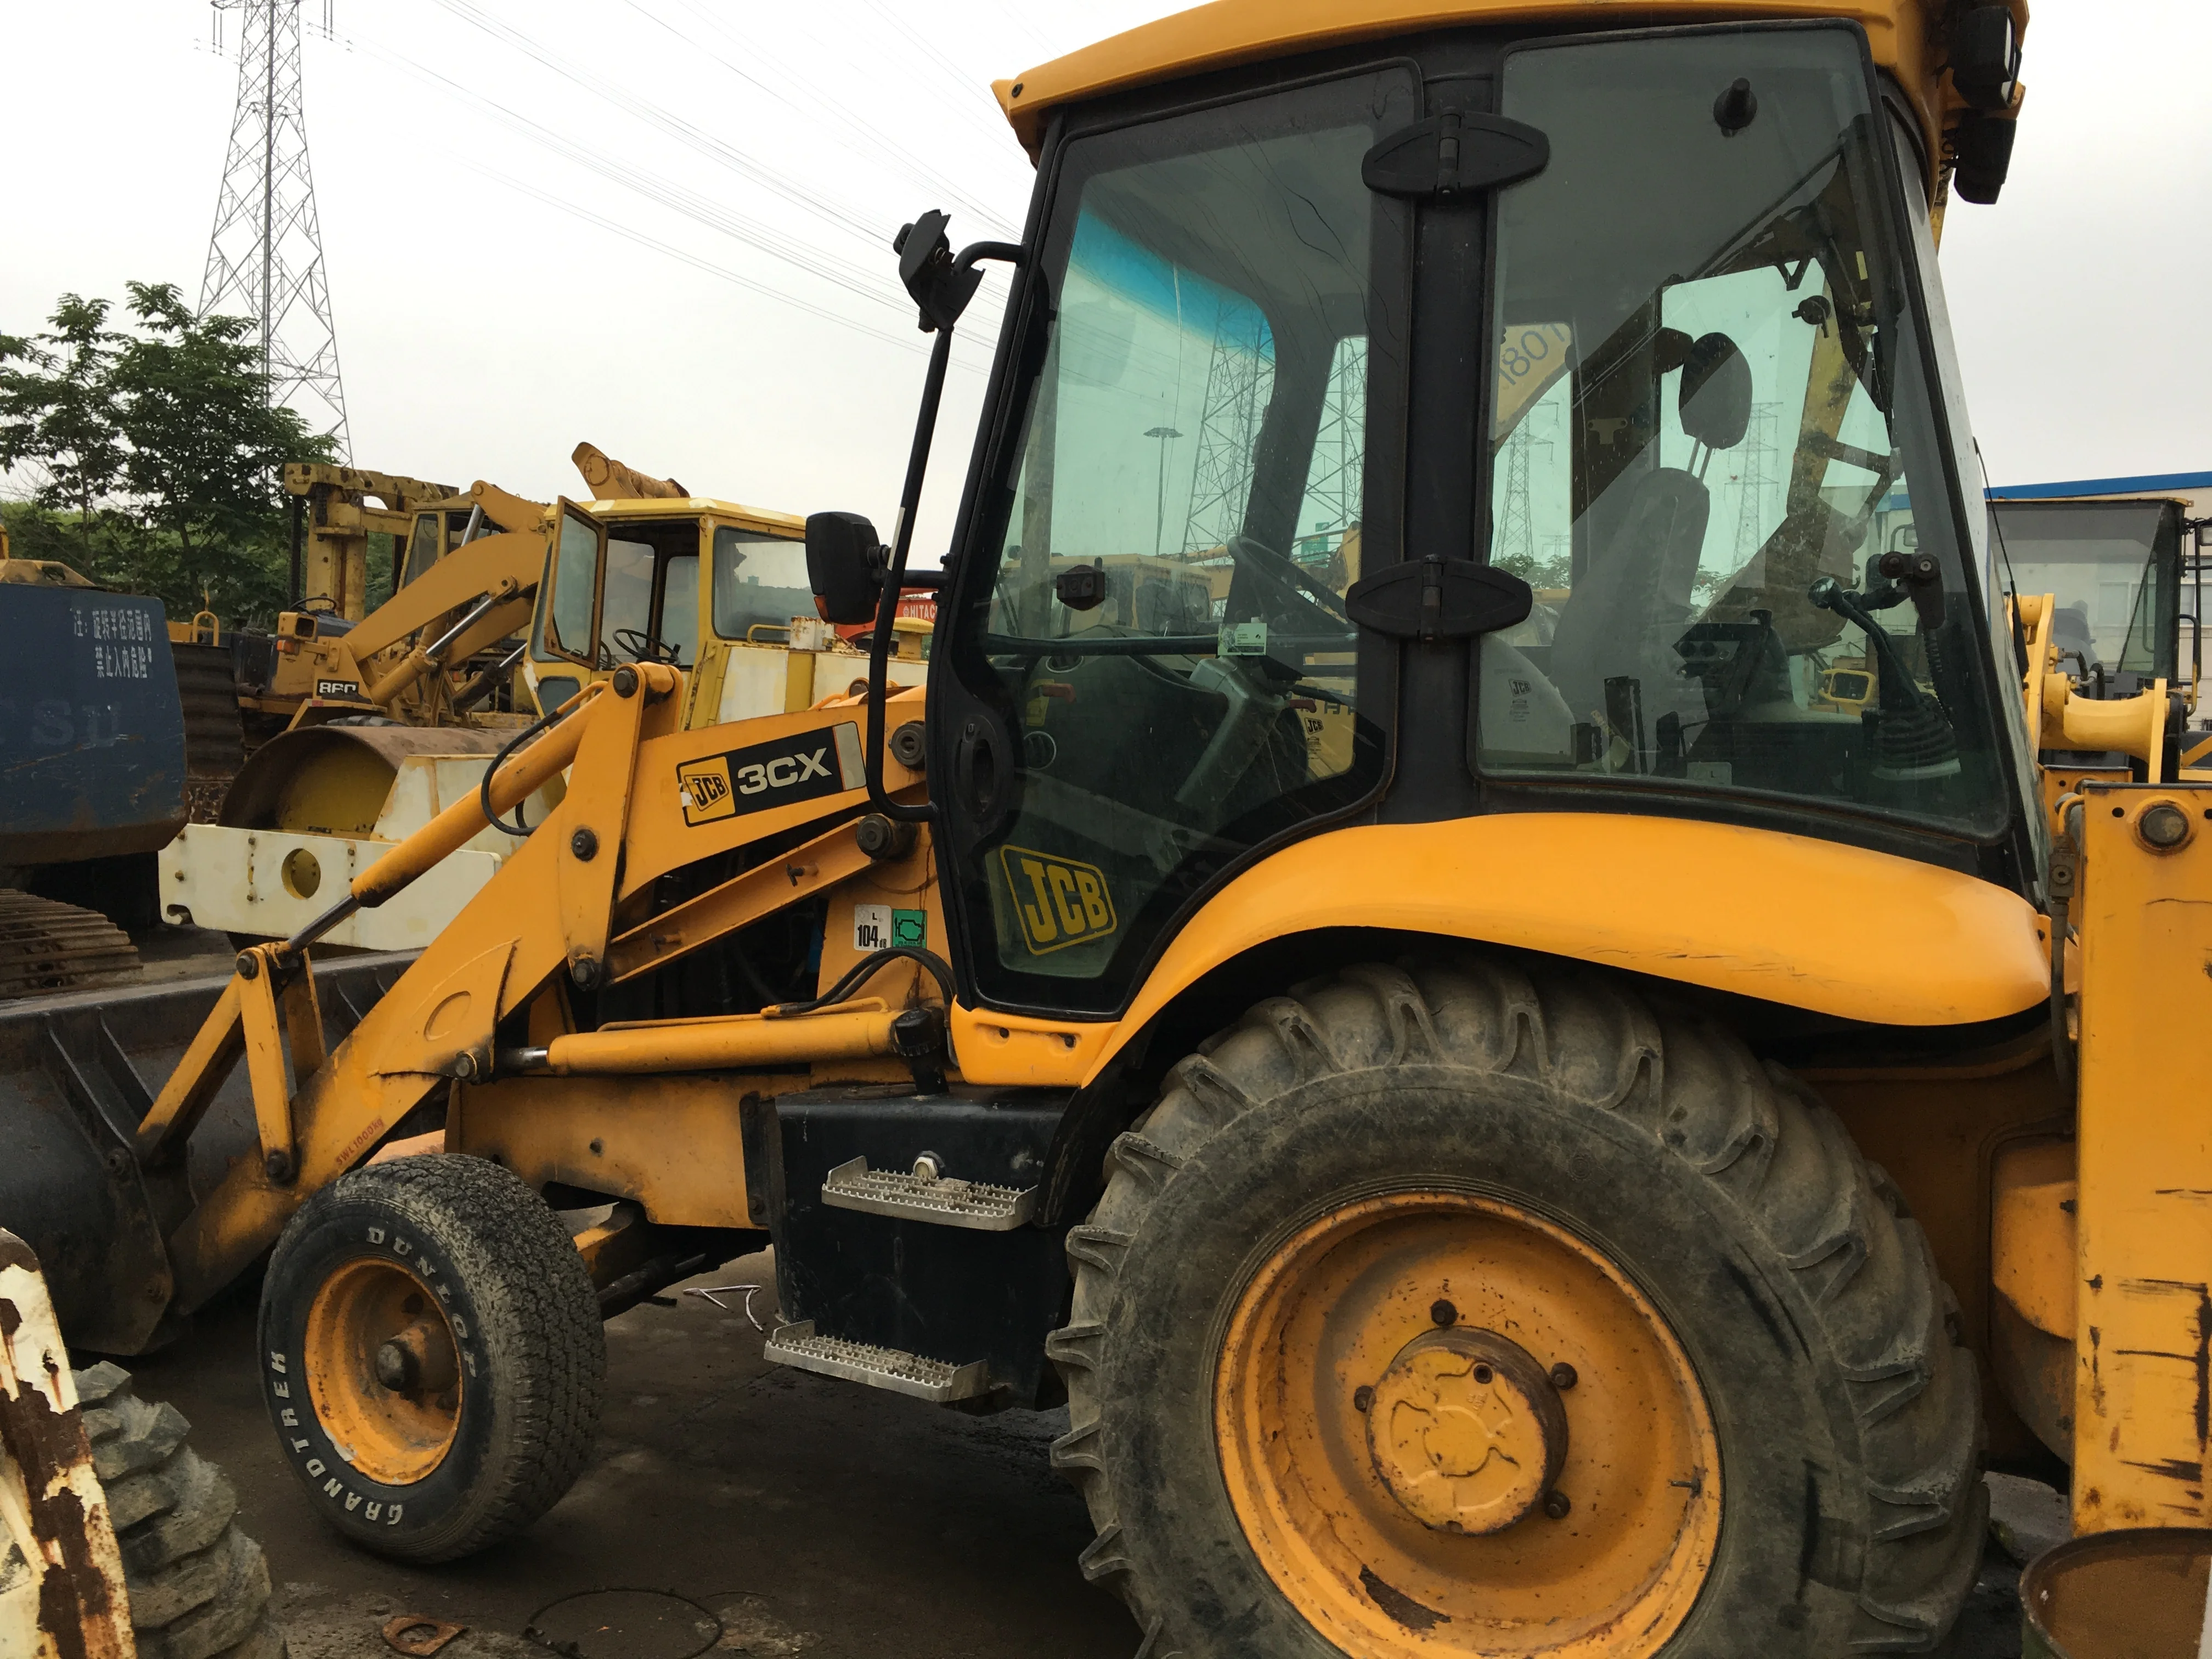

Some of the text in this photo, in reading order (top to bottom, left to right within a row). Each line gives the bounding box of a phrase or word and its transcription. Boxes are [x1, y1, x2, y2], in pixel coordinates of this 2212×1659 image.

[911, 604, 938, 619] HITAC
[1513, 681, 1530, 695] JCB
[1307, 719, 1322, 732] JCB
[738, 747, 832, 794] 3CX
[692, 776, 726, 806] JCB
[1020, 858, 1109, 943] JCB
[336, 1146, 354, 1165] SWL
[366, 1227, 477, 1378] DUNLOP
[271, 1351, 403, 1525] GRANDTREK
